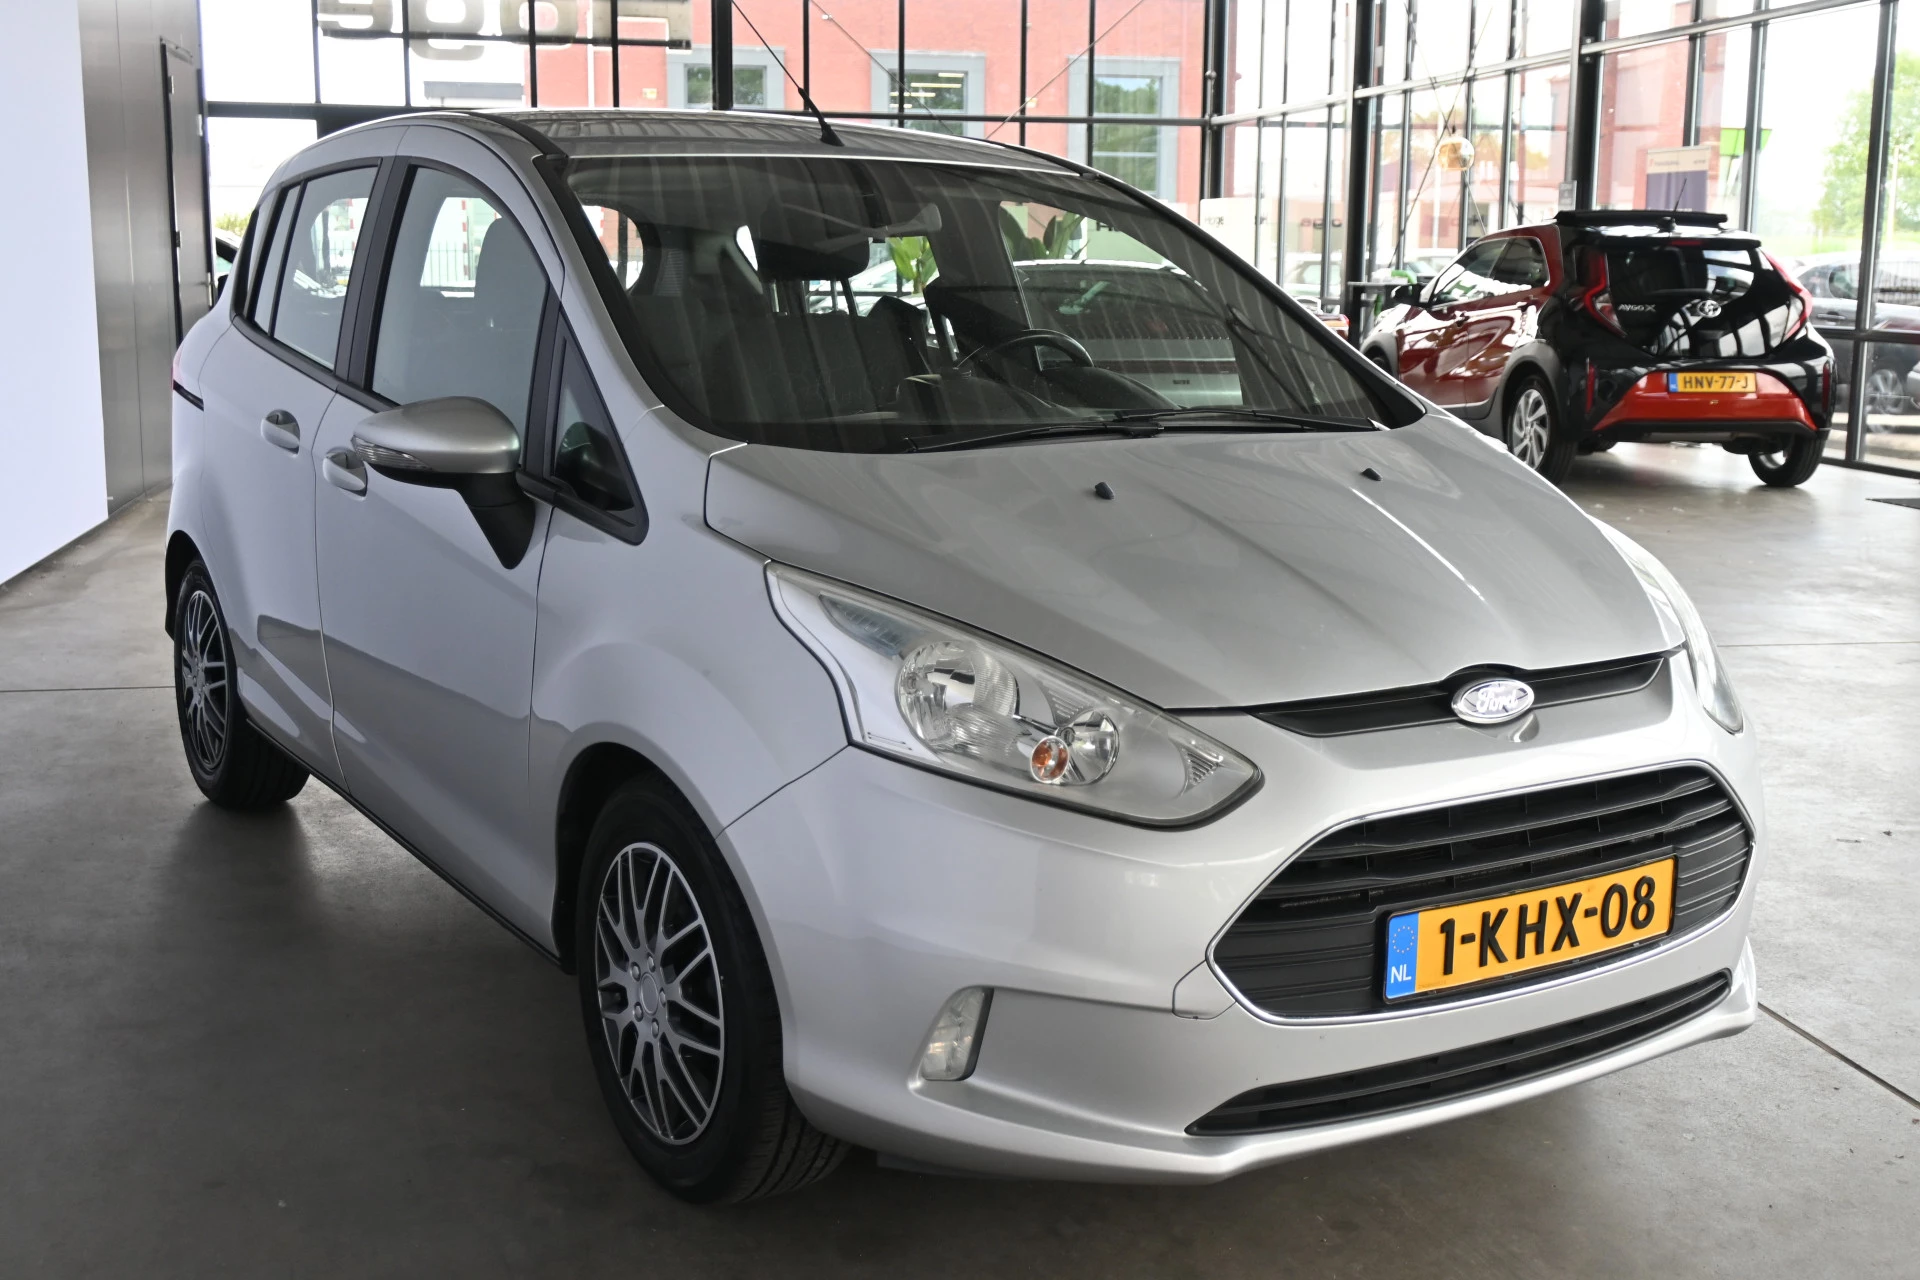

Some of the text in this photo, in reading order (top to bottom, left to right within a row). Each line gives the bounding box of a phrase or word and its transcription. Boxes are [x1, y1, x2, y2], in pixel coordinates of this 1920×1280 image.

[1683, 375, 1749, 389] HNV-77-J
[1476, 686, 1518, 713] Ford
[1390, 876, 1656, 984] NL 1-KHX-08
